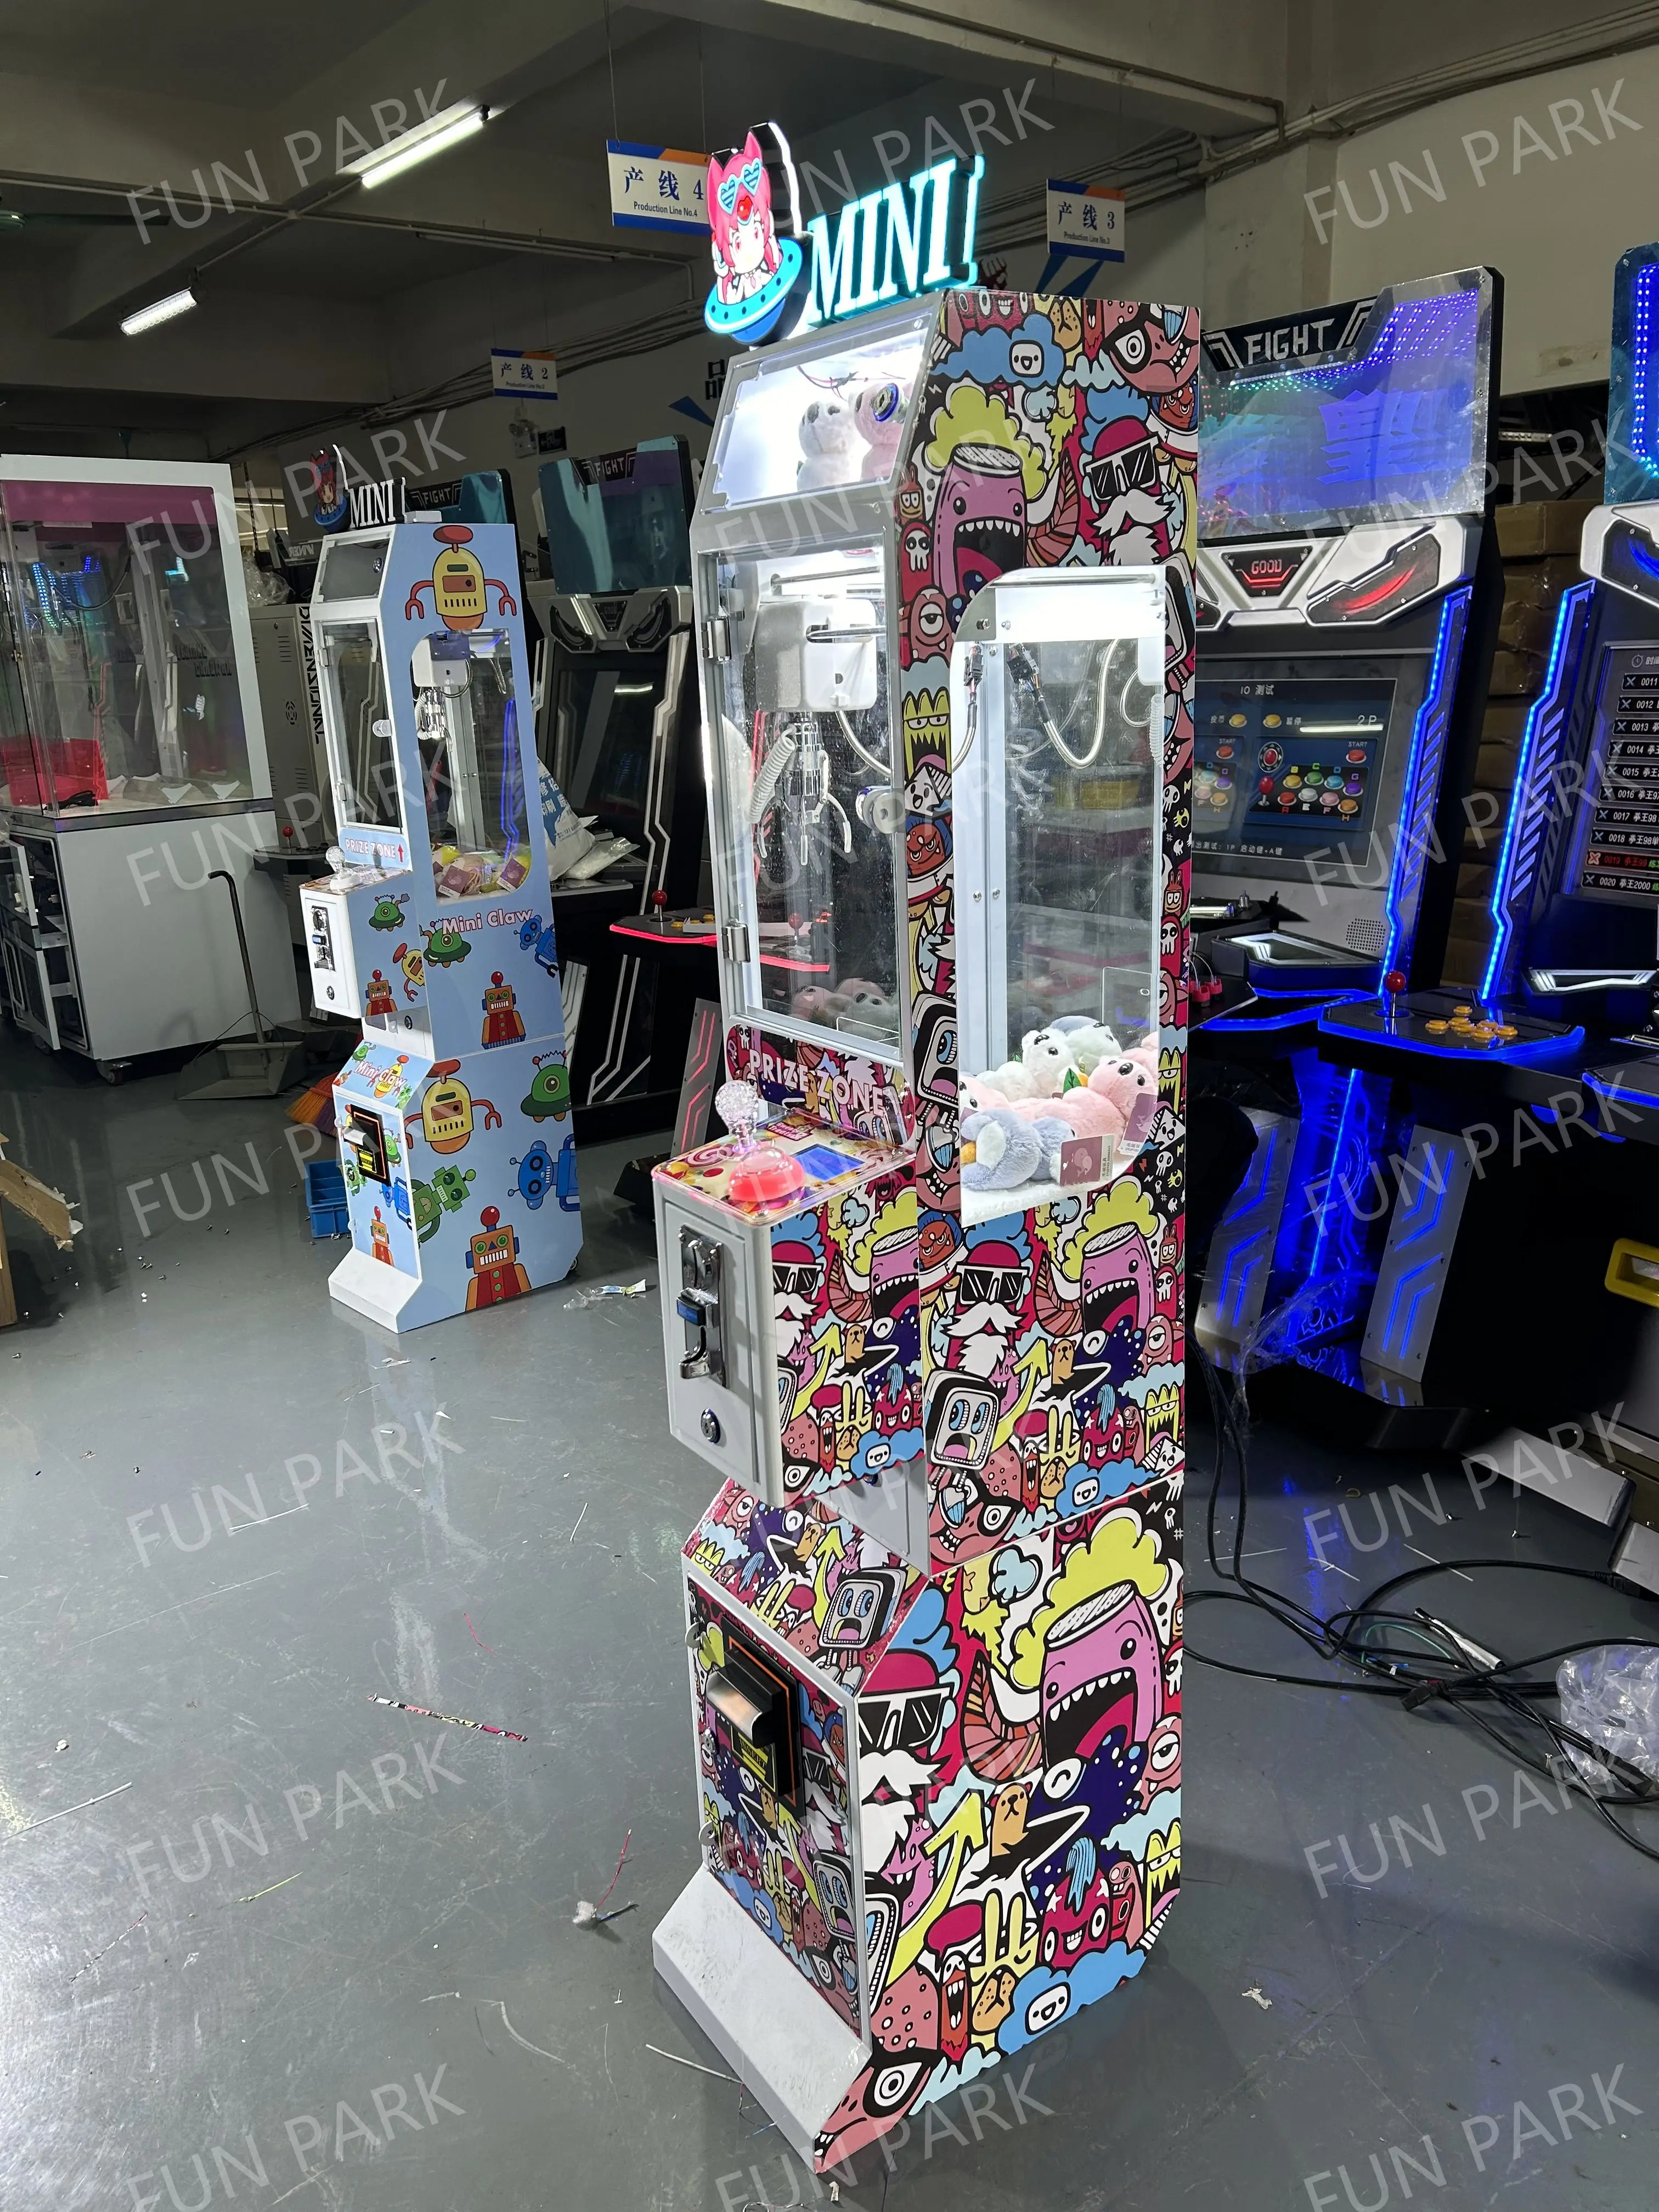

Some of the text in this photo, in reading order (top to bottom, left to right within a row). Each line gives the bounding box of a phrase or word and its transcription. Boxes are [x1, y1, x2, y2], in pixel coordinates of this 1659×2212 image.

[624, 167, 704, 201] 产线 4
[634, 201, 697, 217] Production Line No.4
[1058, 201, 1115, 230] 产线 3
[1064, 231, 1088, 242] Production
[1090, 234, 1098, 243] Line
[1244, 318, 1335, 364] FIGHT
[501, 362, 548, 380] 产线 2
[594, 456, 625, 477] FIGHT
[422, 487, 451, 505] FIGHT
[1251, 559, 1282, 574] GOOD
[1641, 678, 1658, 686] 0011
[1637, 700, 1653, 709] 0012
[1632, 723, 1649, 731] 0013
[1627, 745, 1644, 754] 0014
[1622, 767, 1639, 776] 0015
[1618, 789, 1635, 799] 0016
[1613, 811, 1630, 821] 0017
[1609, 833, 1626, 843] 0018
[344, 837, 397, 859] PRIZE ZONE
[1604, 856, 1621, 865] 0019
[1600, 877, 1616, 887] 0020
[442, 907, 533, 935] Mini Claw
[355, 1060, 408, 1088] Mini Claw
[749, 1048, 884, 1118] PRIZE ZONE
